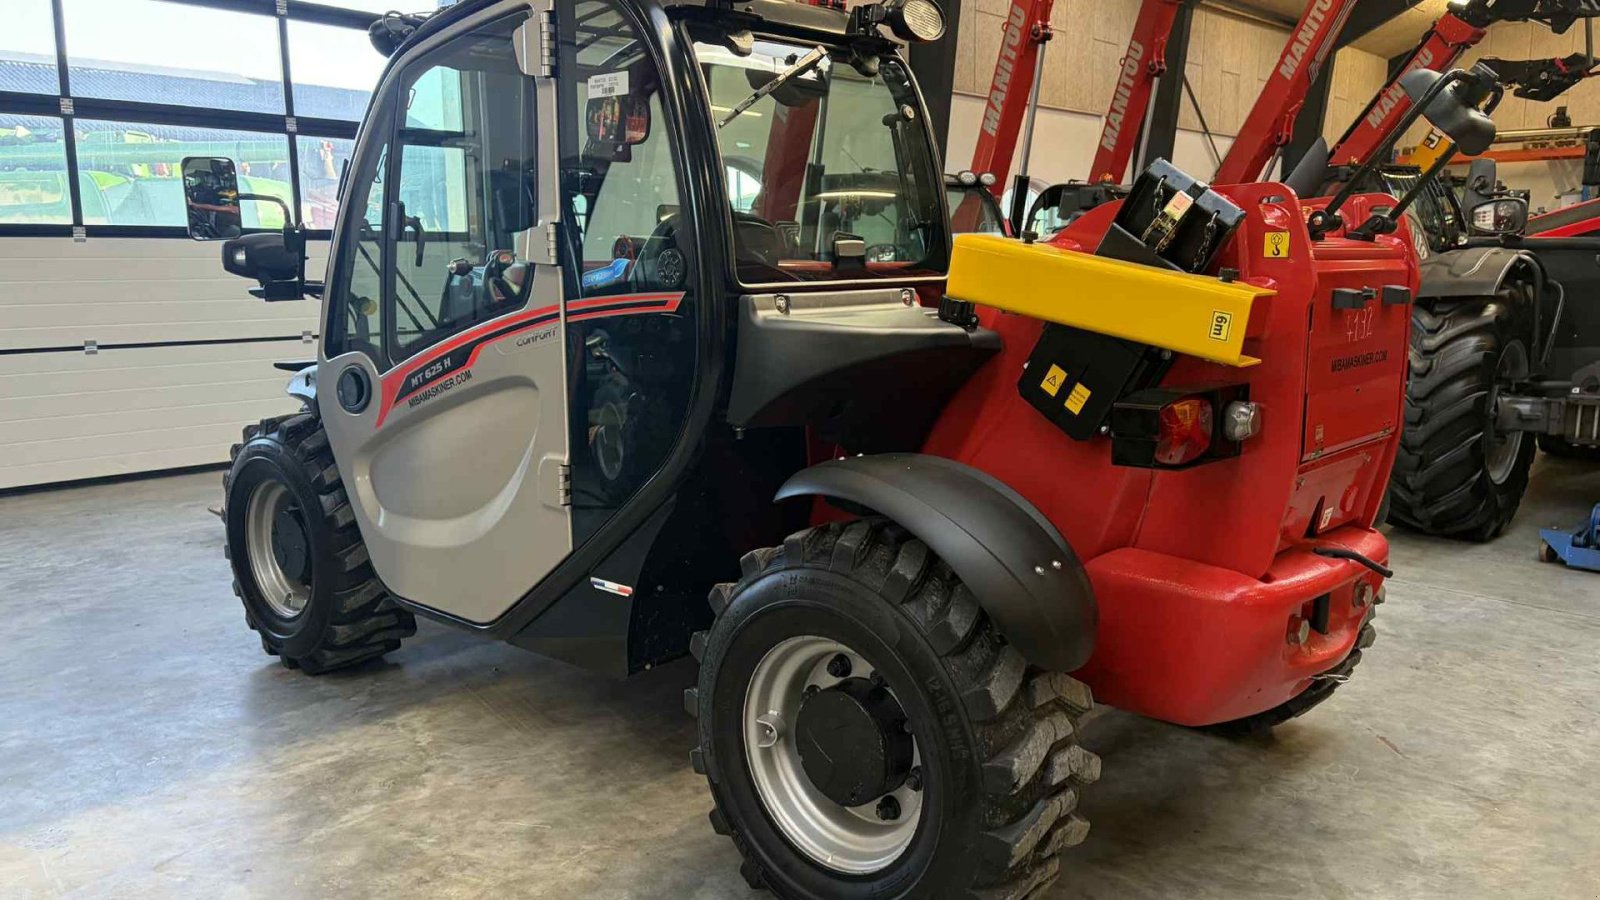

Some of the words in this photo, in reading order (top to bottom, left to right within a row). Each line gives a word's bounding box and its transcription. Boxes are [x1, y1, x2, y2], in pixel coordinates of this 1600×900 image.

[983, 4, 1025, 137] MANITOU
[1101, 40, 1143, 152] MANITOU
[1213, 315, 1227, 336] 6m
[411, 373, 424, 388] MT
[425, 362, 443, 379] 625
[443, 357, 451, 369] H
[1332, 350, 1388, 372] MIBAMASKINER.COM
[408, 369, 473, 408] MIBAMASKINER.COM
